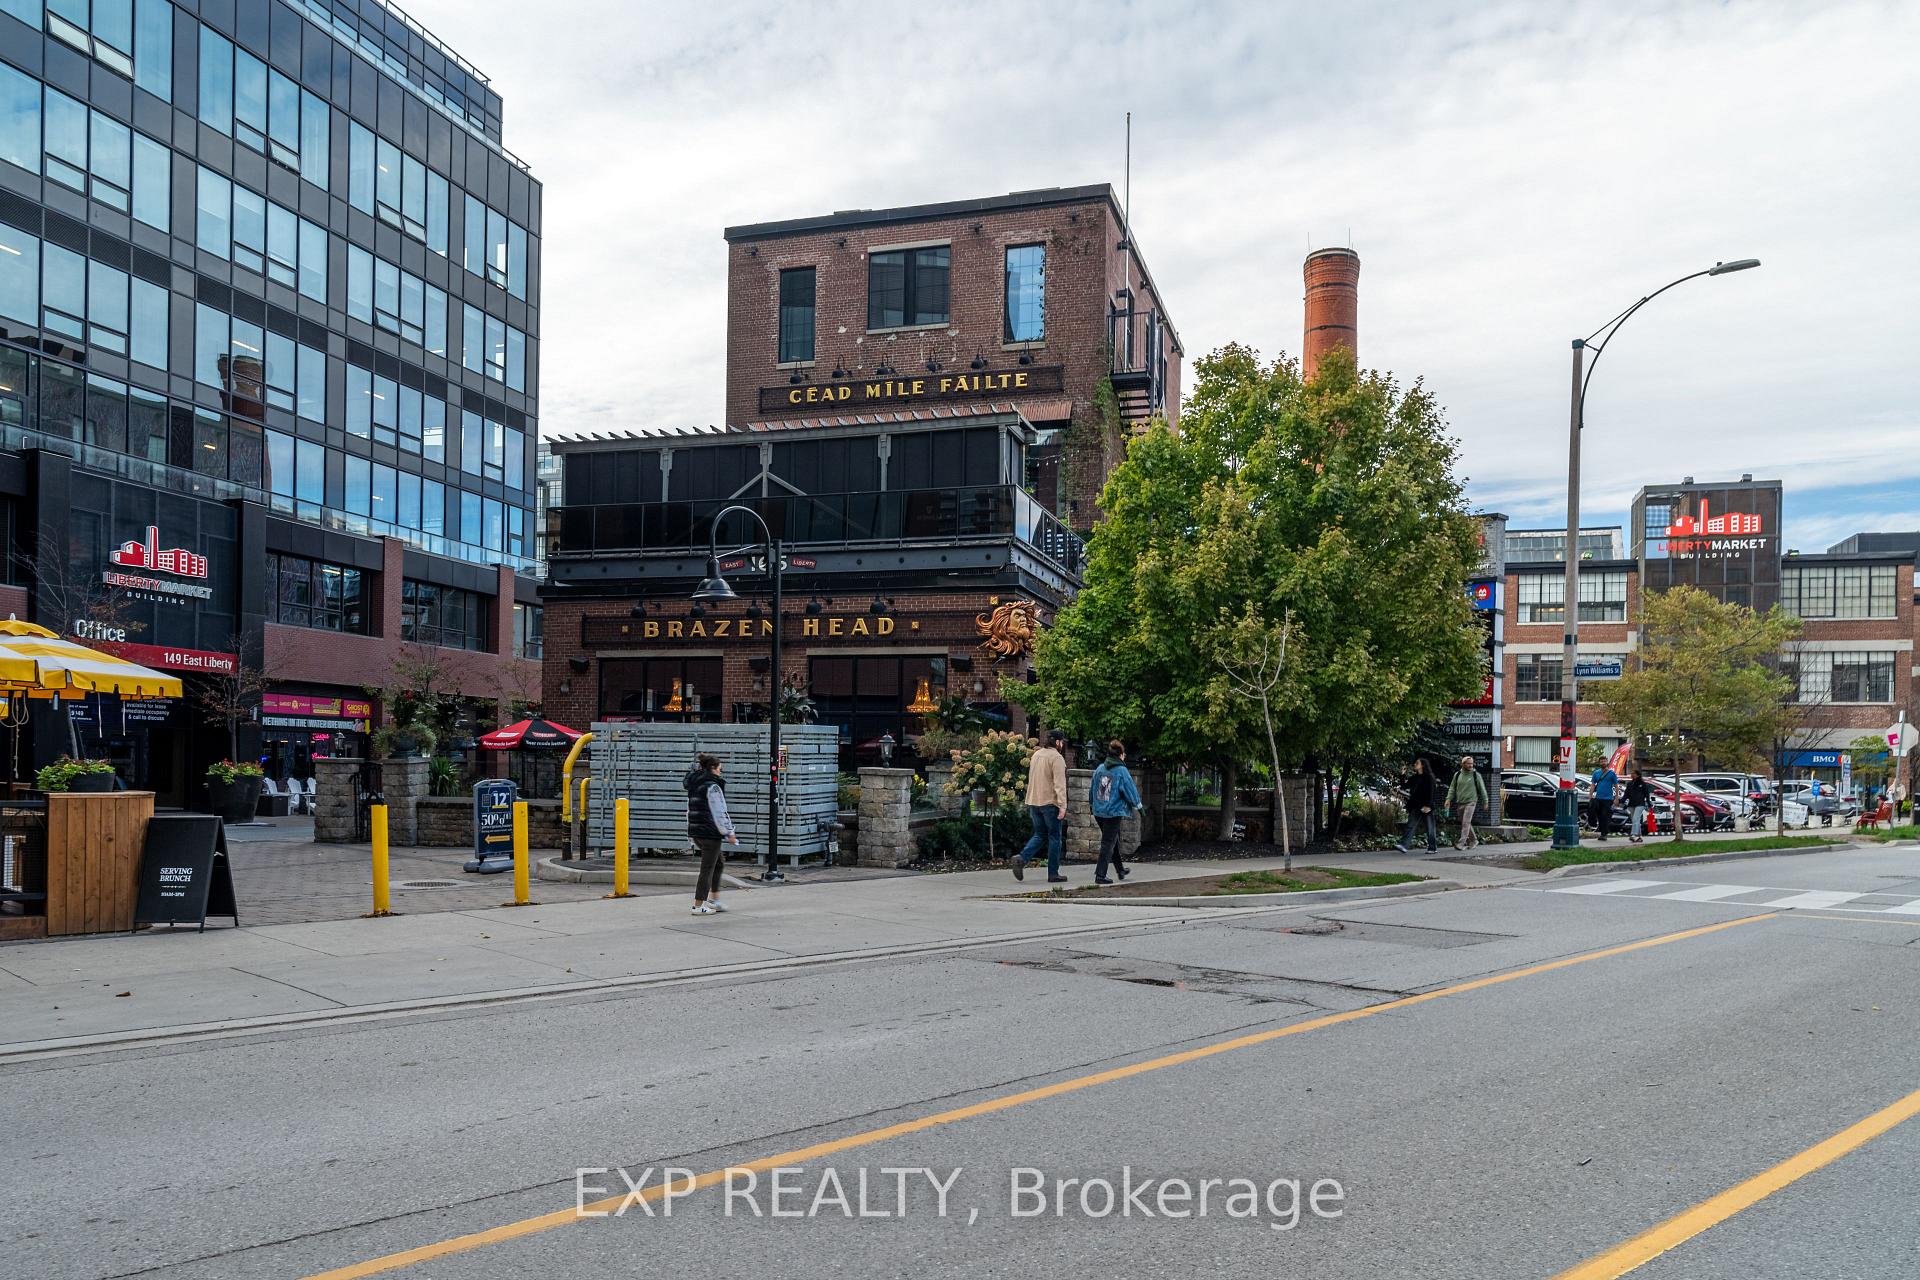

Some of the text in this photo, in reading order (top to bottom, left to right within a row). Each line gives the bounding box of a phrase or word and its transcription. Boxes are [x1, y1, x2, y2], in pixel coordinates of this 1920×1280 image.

[1680, 552, 1740, 560] BUILDING
[104, 571, 213, 600] LIBERTYMARKET
[127, 591, 185, 605] BUILDING
[75, 618, 126, 642] Office
[803, 616, 895, 637] HEAD
[164, 652, 233, 671] 149 East Liberty
[1576, 667, 1590, 676] Lynn
[1590, 665, 1614, 675] Williams
[1812, 755, 1836, 763] BMO
[160, 867, 193, 875] SERVING
